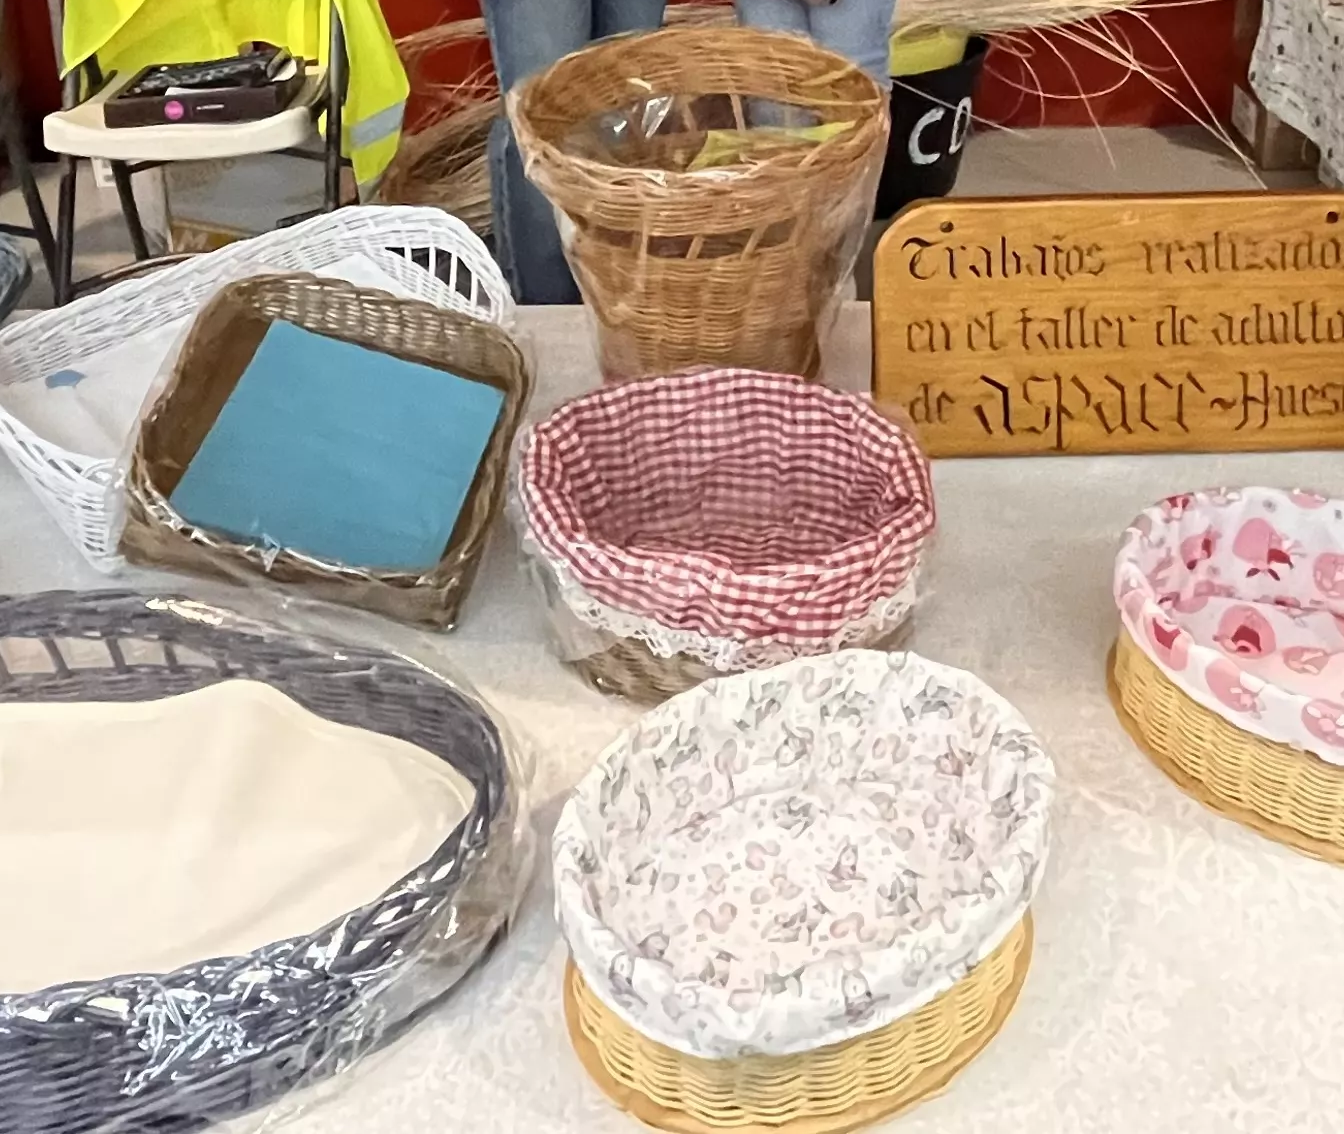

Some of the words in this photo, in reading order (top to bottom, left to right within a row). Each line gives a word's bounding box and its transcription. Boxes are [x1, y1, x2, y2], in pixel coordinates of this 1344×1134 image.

[901, 234, 1106, 281] Trabajos
[906, 319, 952, 353] en
[966, 310, 1001, 352] el
[1016, 306, 1137, 351] taller
[1156, 304, 1199, 347] de
[909, 381, 956, 424] de
